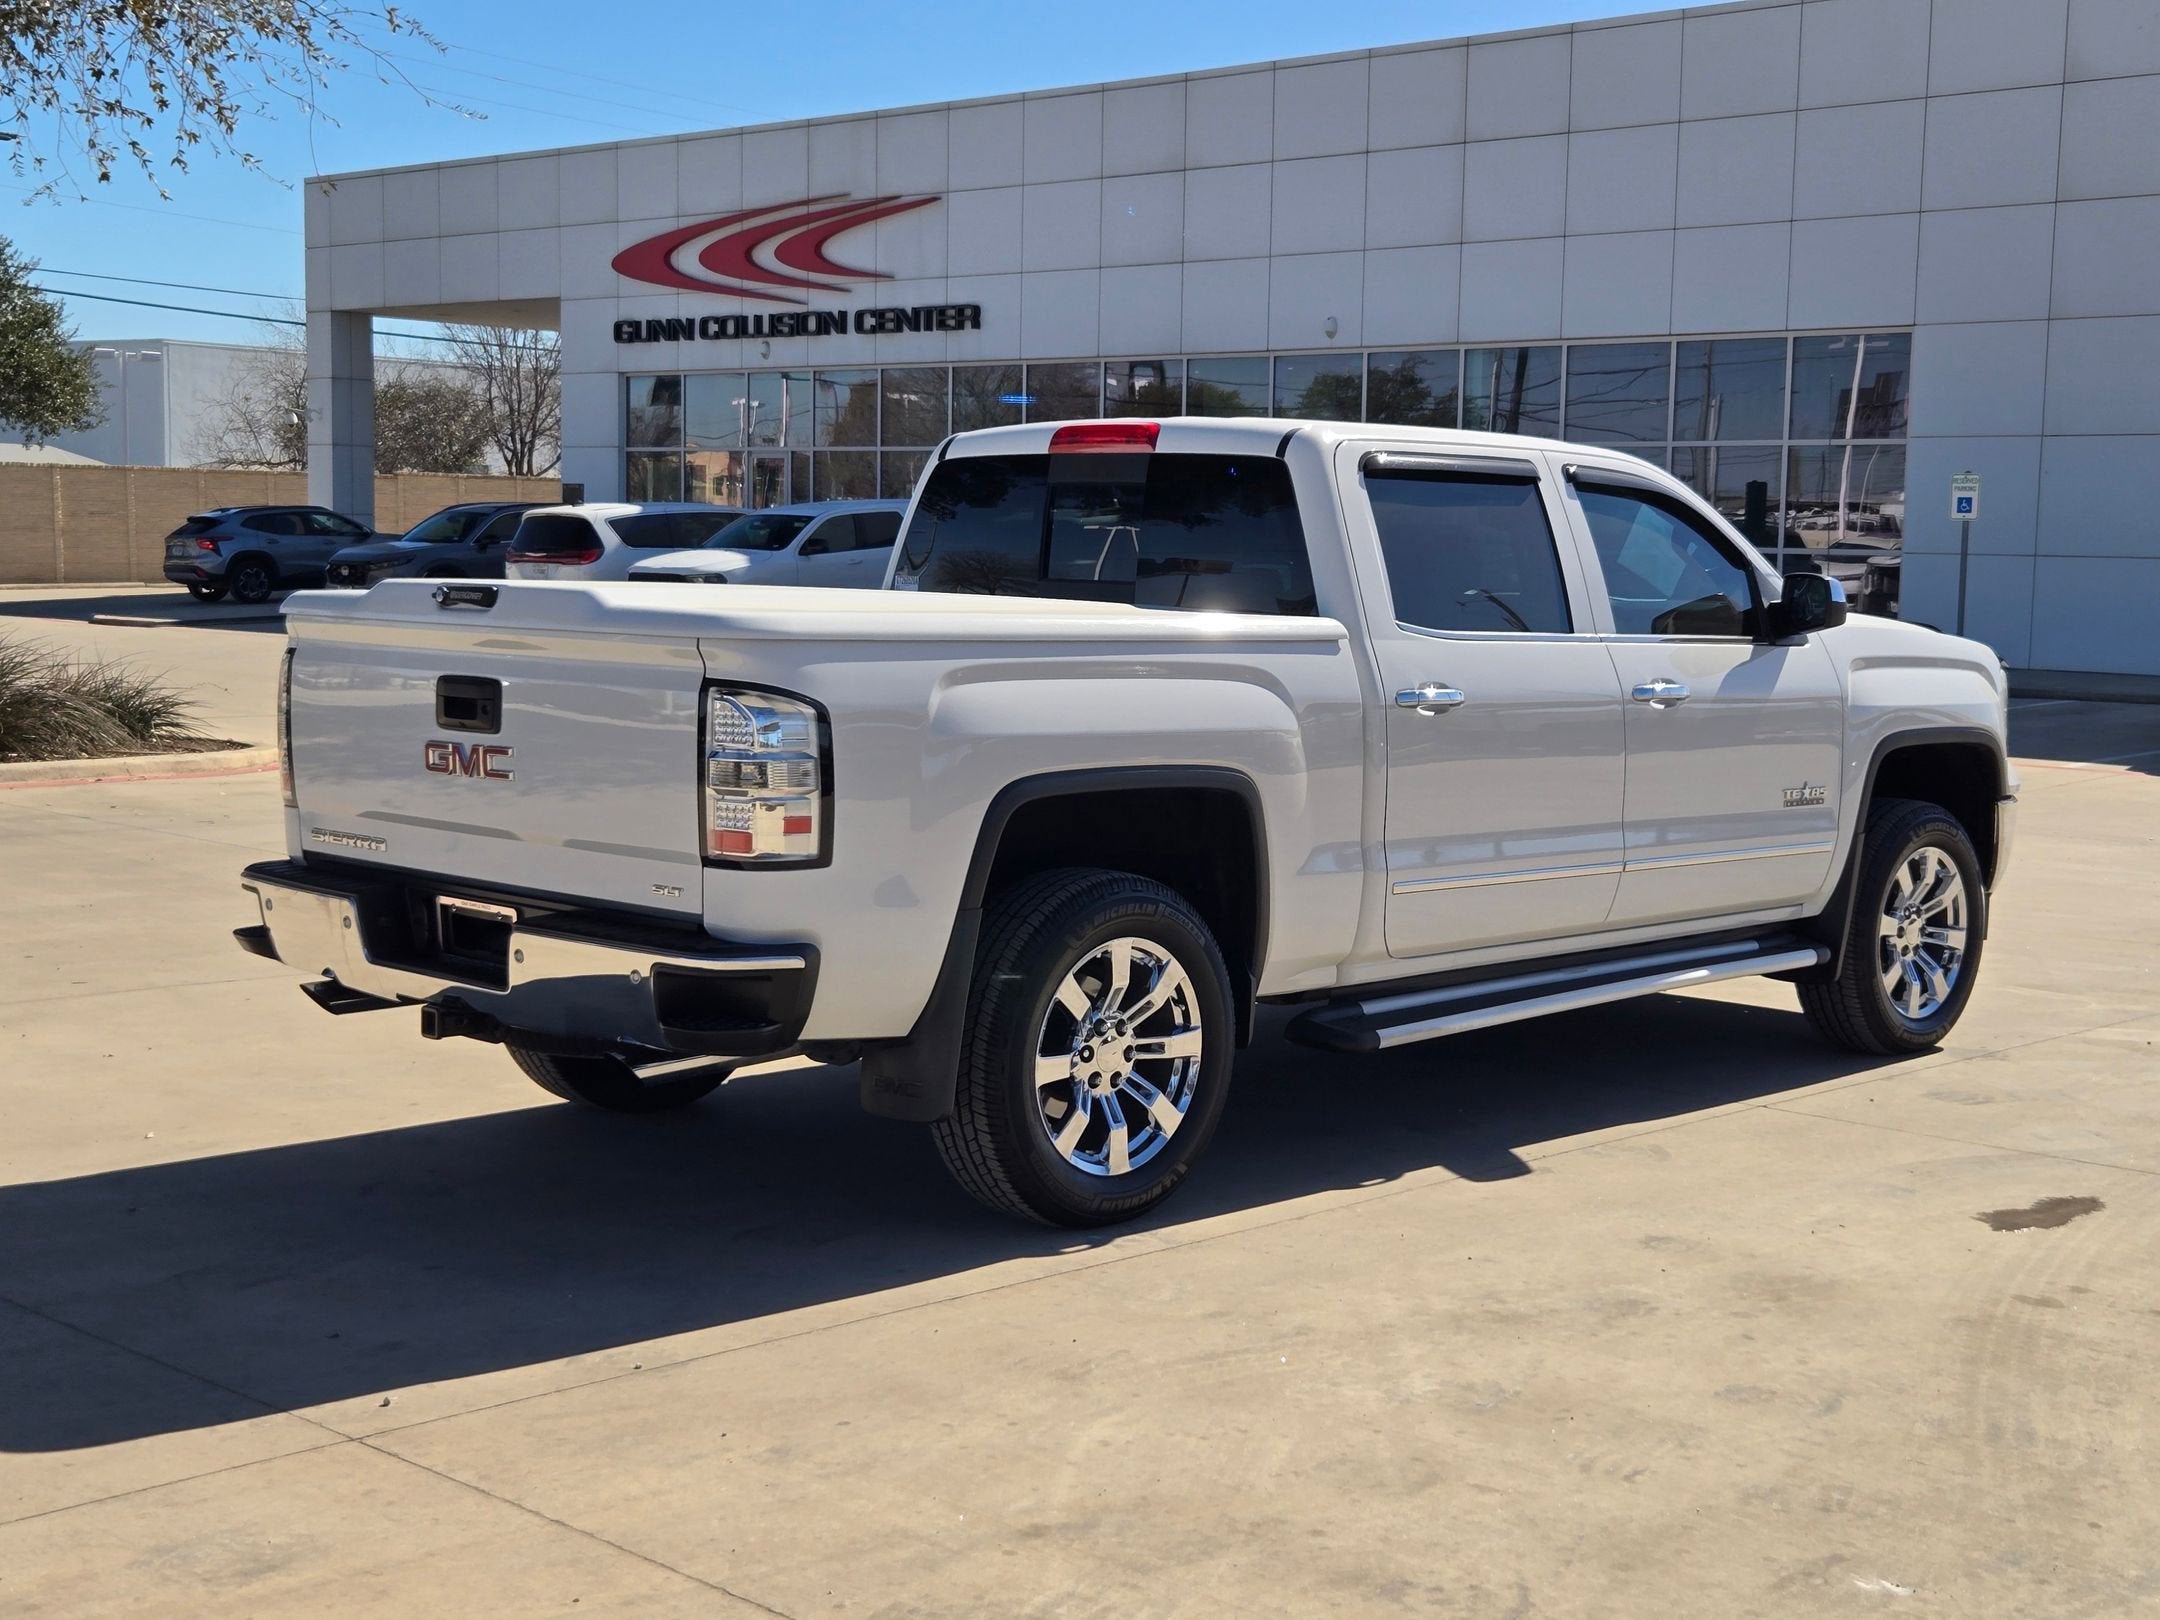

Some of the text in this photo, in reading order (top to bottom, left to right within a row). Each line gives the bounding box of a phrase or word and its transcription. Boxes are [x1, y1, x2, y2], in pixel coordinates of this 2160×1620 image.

[614, 304, 982, 344] GUNN COLLISION CENTER
[424, 739, 516, 782] GMC
[1782, 780, 1827, 801] TEXAS
[311, 827, 388, 853] SIERRA
[651, 884, 685, 898] SLT
[1094, 903, 1157, 928] MICHELIN
